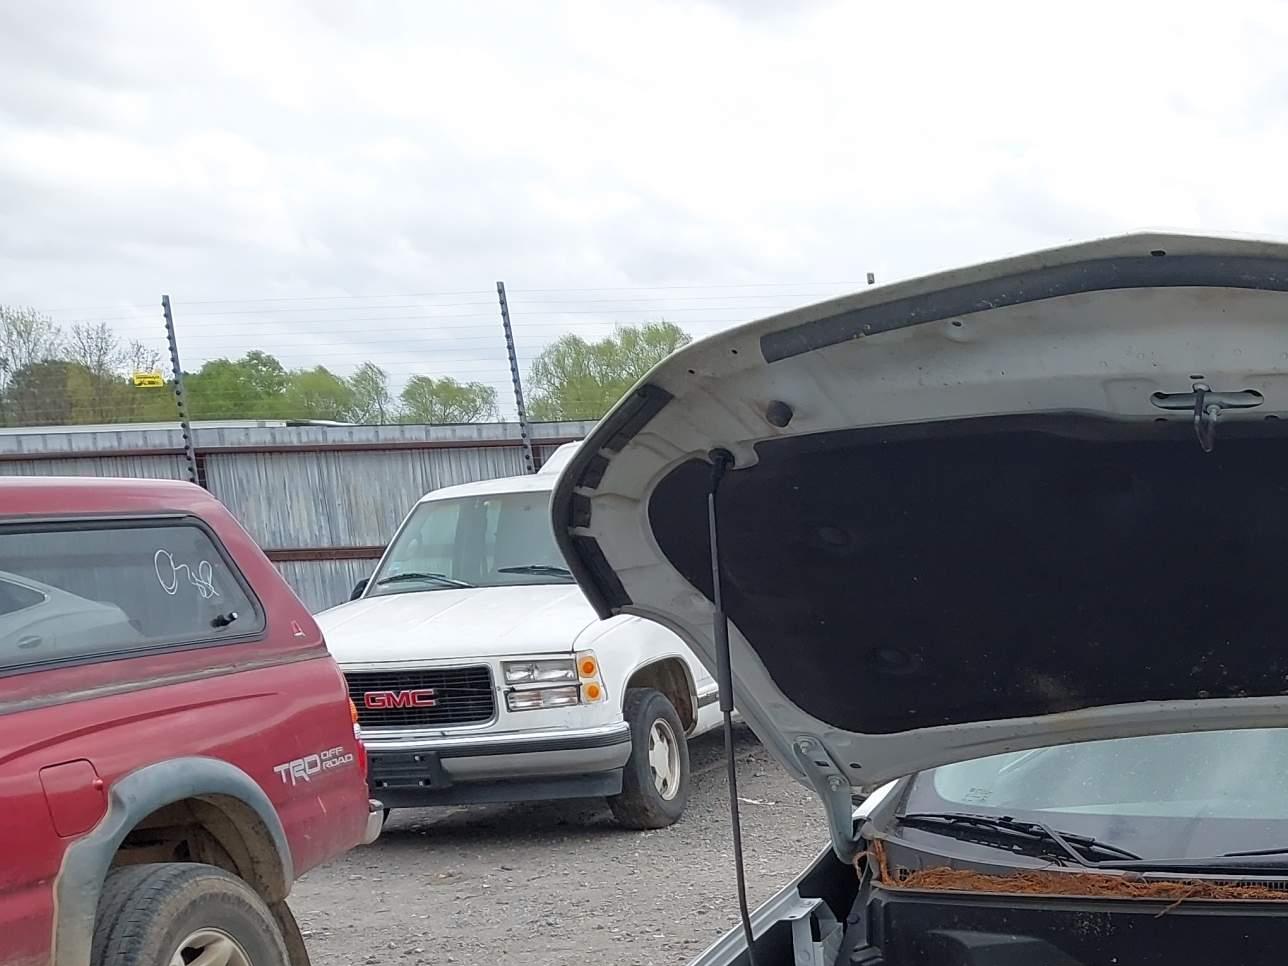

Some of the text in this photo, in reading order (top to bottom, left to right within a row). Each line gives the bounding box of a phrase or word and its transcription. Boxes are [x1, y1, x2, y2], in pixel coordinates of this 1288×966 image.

[364, 688, 437, 709] GMC
[320, 746, 344, 760] OFF
[322, 753, 354, 770] ROAD
[273, 753, 321, 787] TRD
